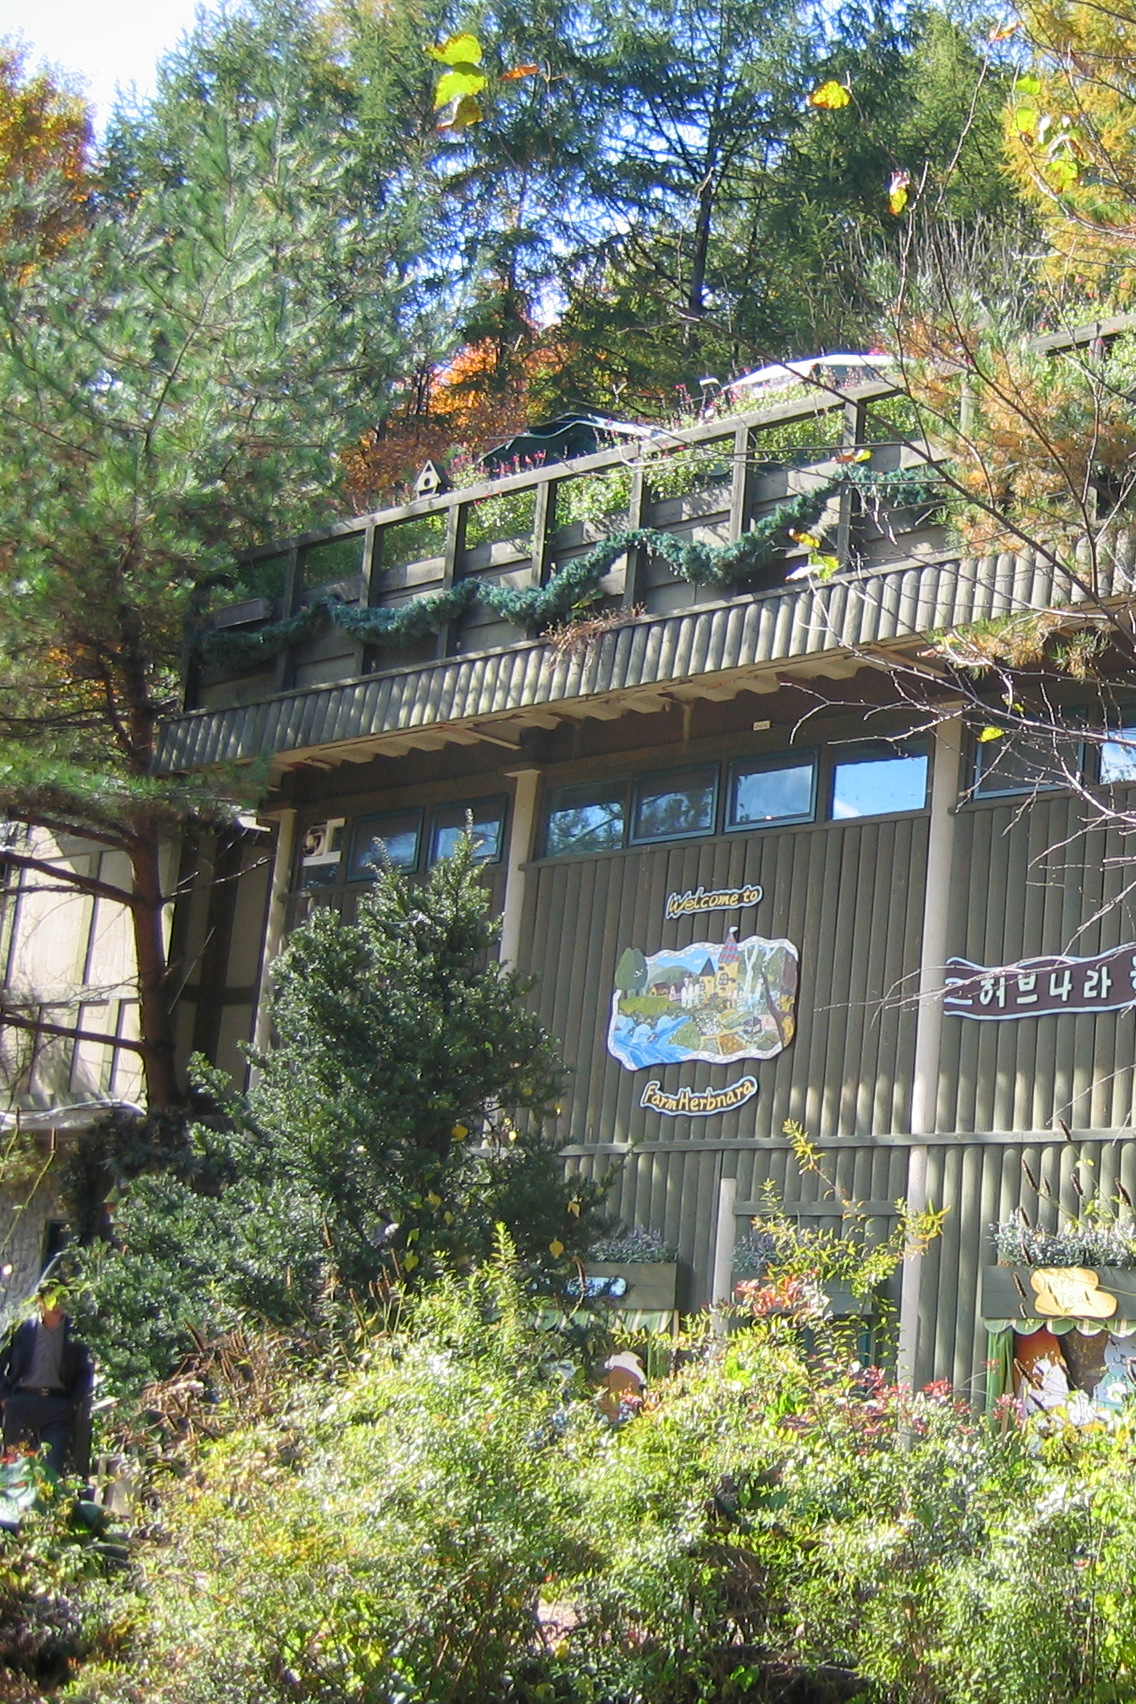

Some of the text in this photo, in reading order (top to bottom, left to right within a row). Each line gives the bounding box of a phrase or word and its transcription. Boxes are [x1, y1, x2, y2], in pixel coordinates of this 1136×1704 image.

[669, 889, 758, 914] Welcome to
[979, 965, 1112, 1008] 허브나라
[1061, 1293, 1086, 1306] Tea
